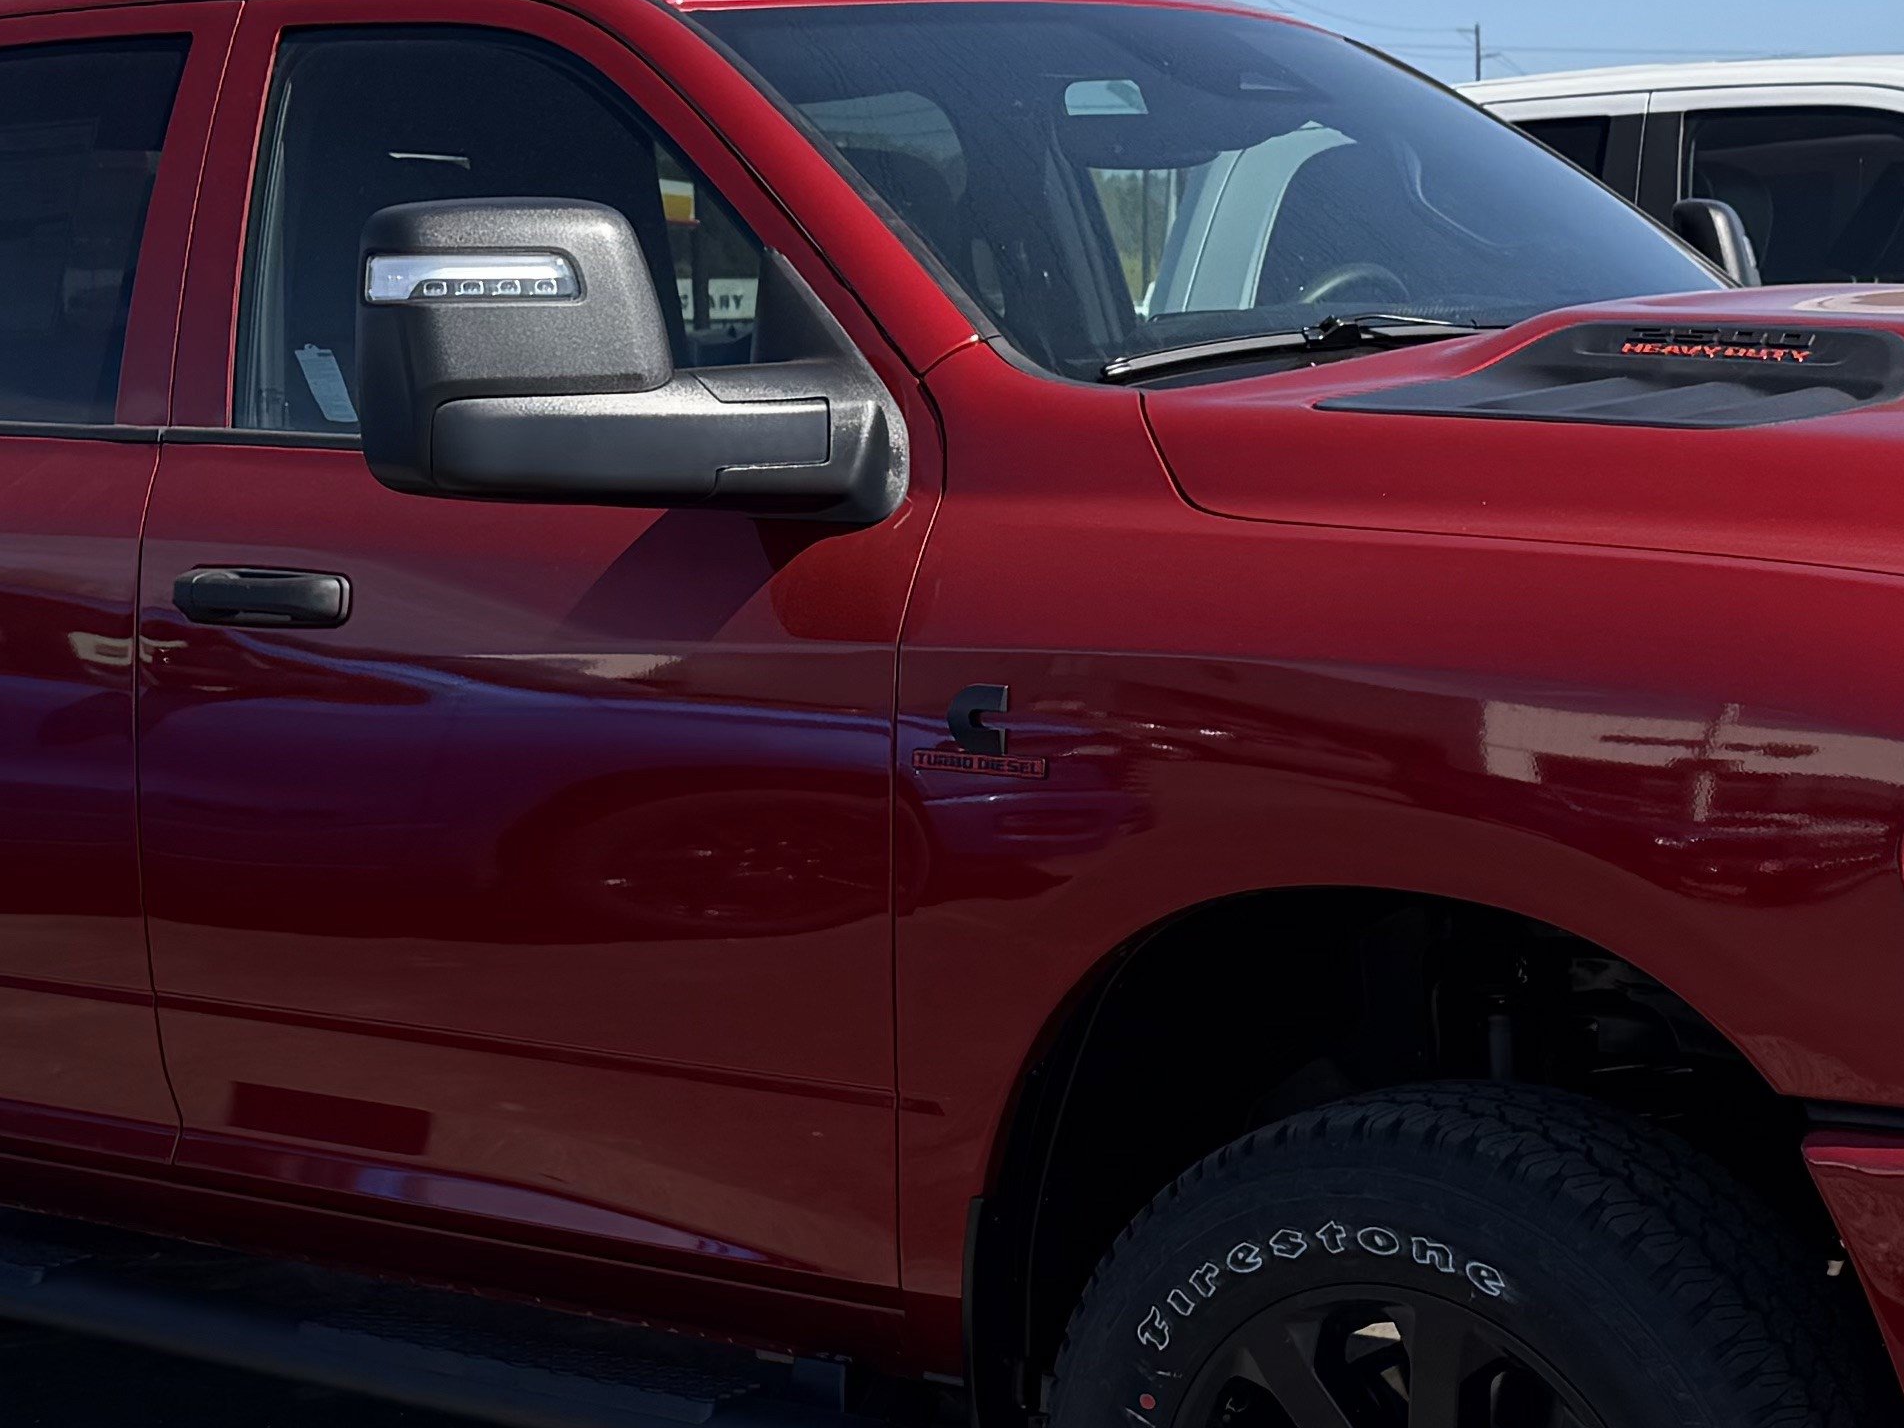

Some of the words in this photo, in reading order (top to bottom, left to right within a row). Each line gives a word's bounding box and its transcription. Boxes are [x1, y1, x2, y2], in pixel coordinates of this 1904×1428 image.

[1620, 342, 1721, 359] HEAVY
[1723, 346, 1813, 363] DUTY
[917, 751, 974, 770] TURBO
[977, 757, 1039, 775] DIESEL
[1137, 1220, 1506, 1352] Firestone
